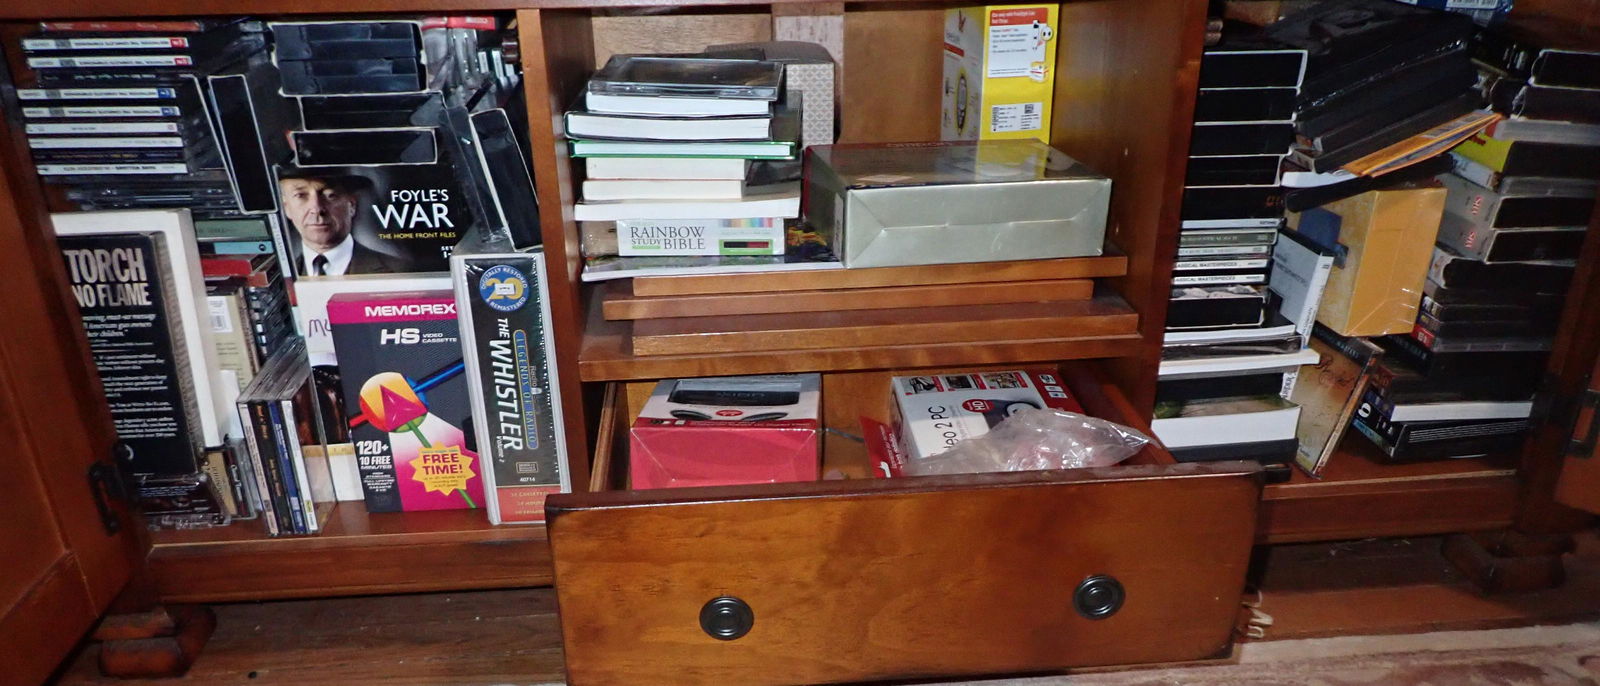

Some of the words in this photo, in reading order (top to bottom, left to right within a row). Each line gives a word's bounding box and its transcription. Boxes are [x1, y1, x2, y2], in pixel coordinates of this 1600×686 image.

[391, 189, 449, 202] FOYLE'S
[372, 203, 454, 229] WAR
[630, 226, 705, 239] RAINBOW
[664, 238, 706, 250] BIBLE
[62, 248, 147, 283] TORCH
[96, 282, 152, 307] FLAME
[365, 303, 456, 317] MEMOREX
[497, 318, 511, 338] THE
[380, 328, 420, 345] HS
[489, 339, 523, 450] WHISTLER
[928, 405, 949, 420] PC
[971, 401, 986, 410] HD
[356, 440, 389, 455] 120+
[360, 456, 370, 466] 10
[371, 455, 391, 466] FREE
[423, 453, 459, 464] FREE
[422, 464, 463, 475] TIME!
